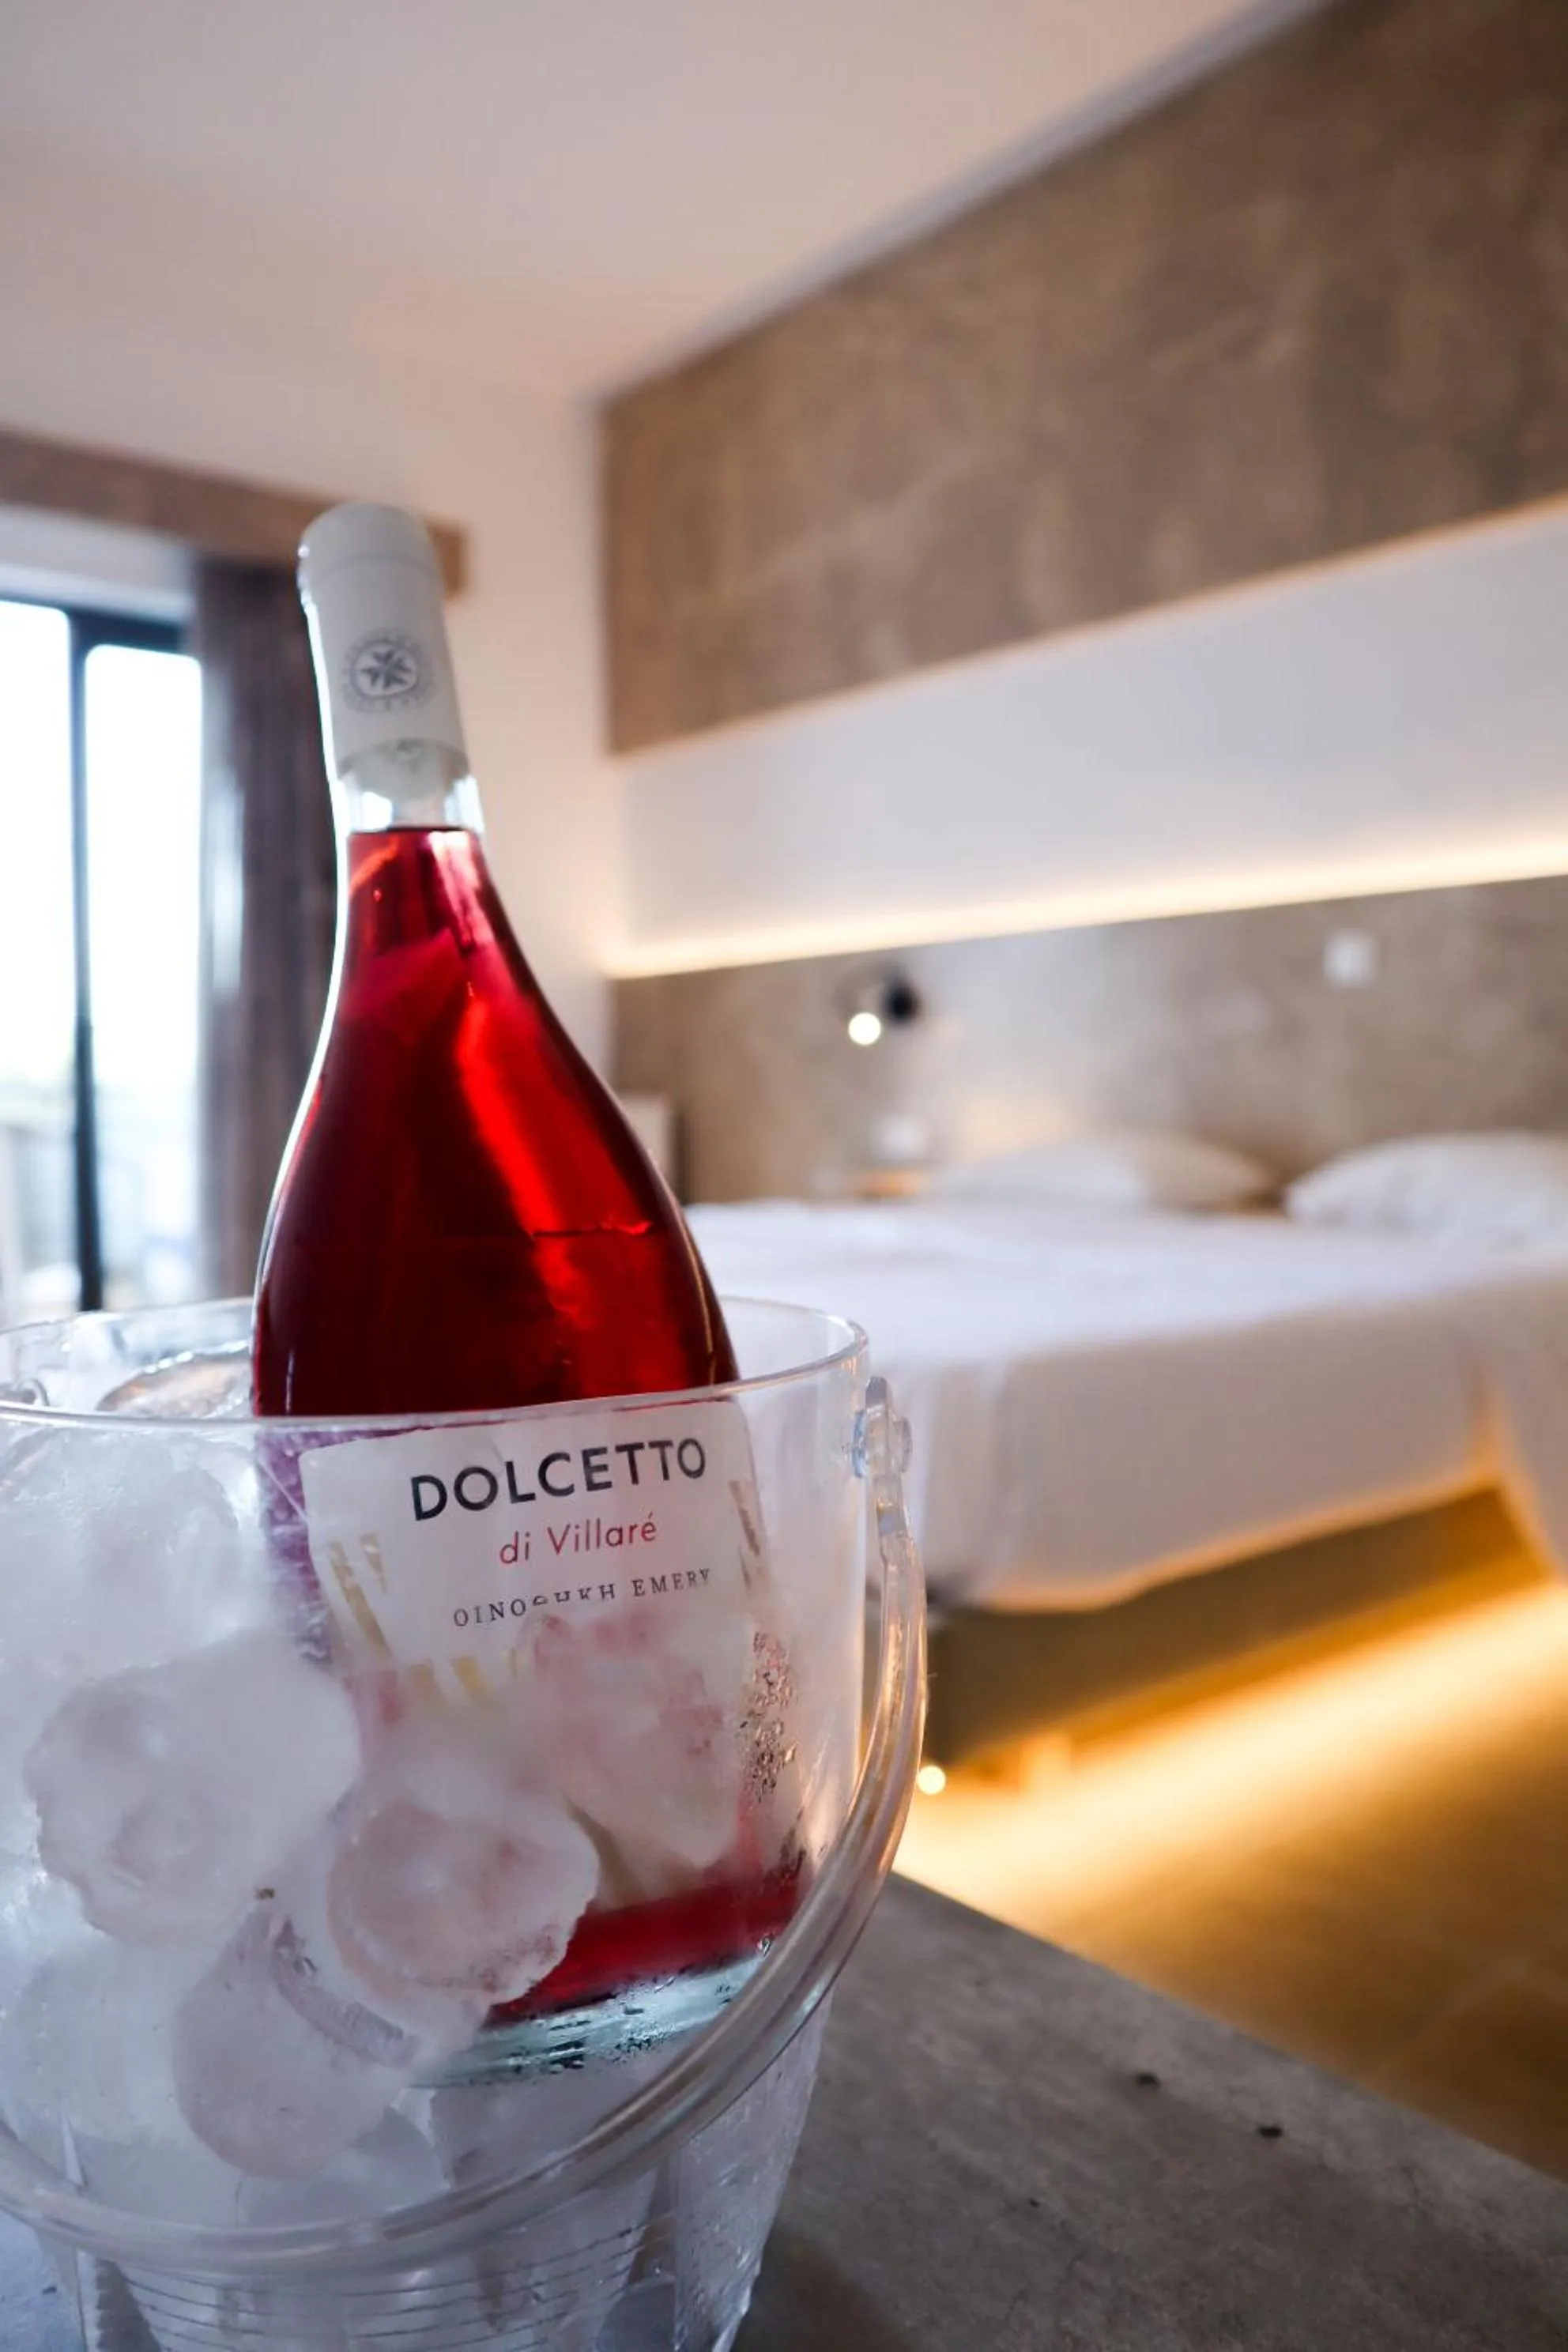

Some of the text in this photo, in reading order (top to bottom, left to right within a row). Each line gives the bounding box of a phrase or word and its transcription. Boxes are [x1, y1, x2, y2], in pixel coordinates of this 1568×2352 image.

[410, 1438, 707, 1521] DOLCETTO
[499, 1512, 657, 1564] di Villaré
[631, 1567, 710, 1596] EMERY
